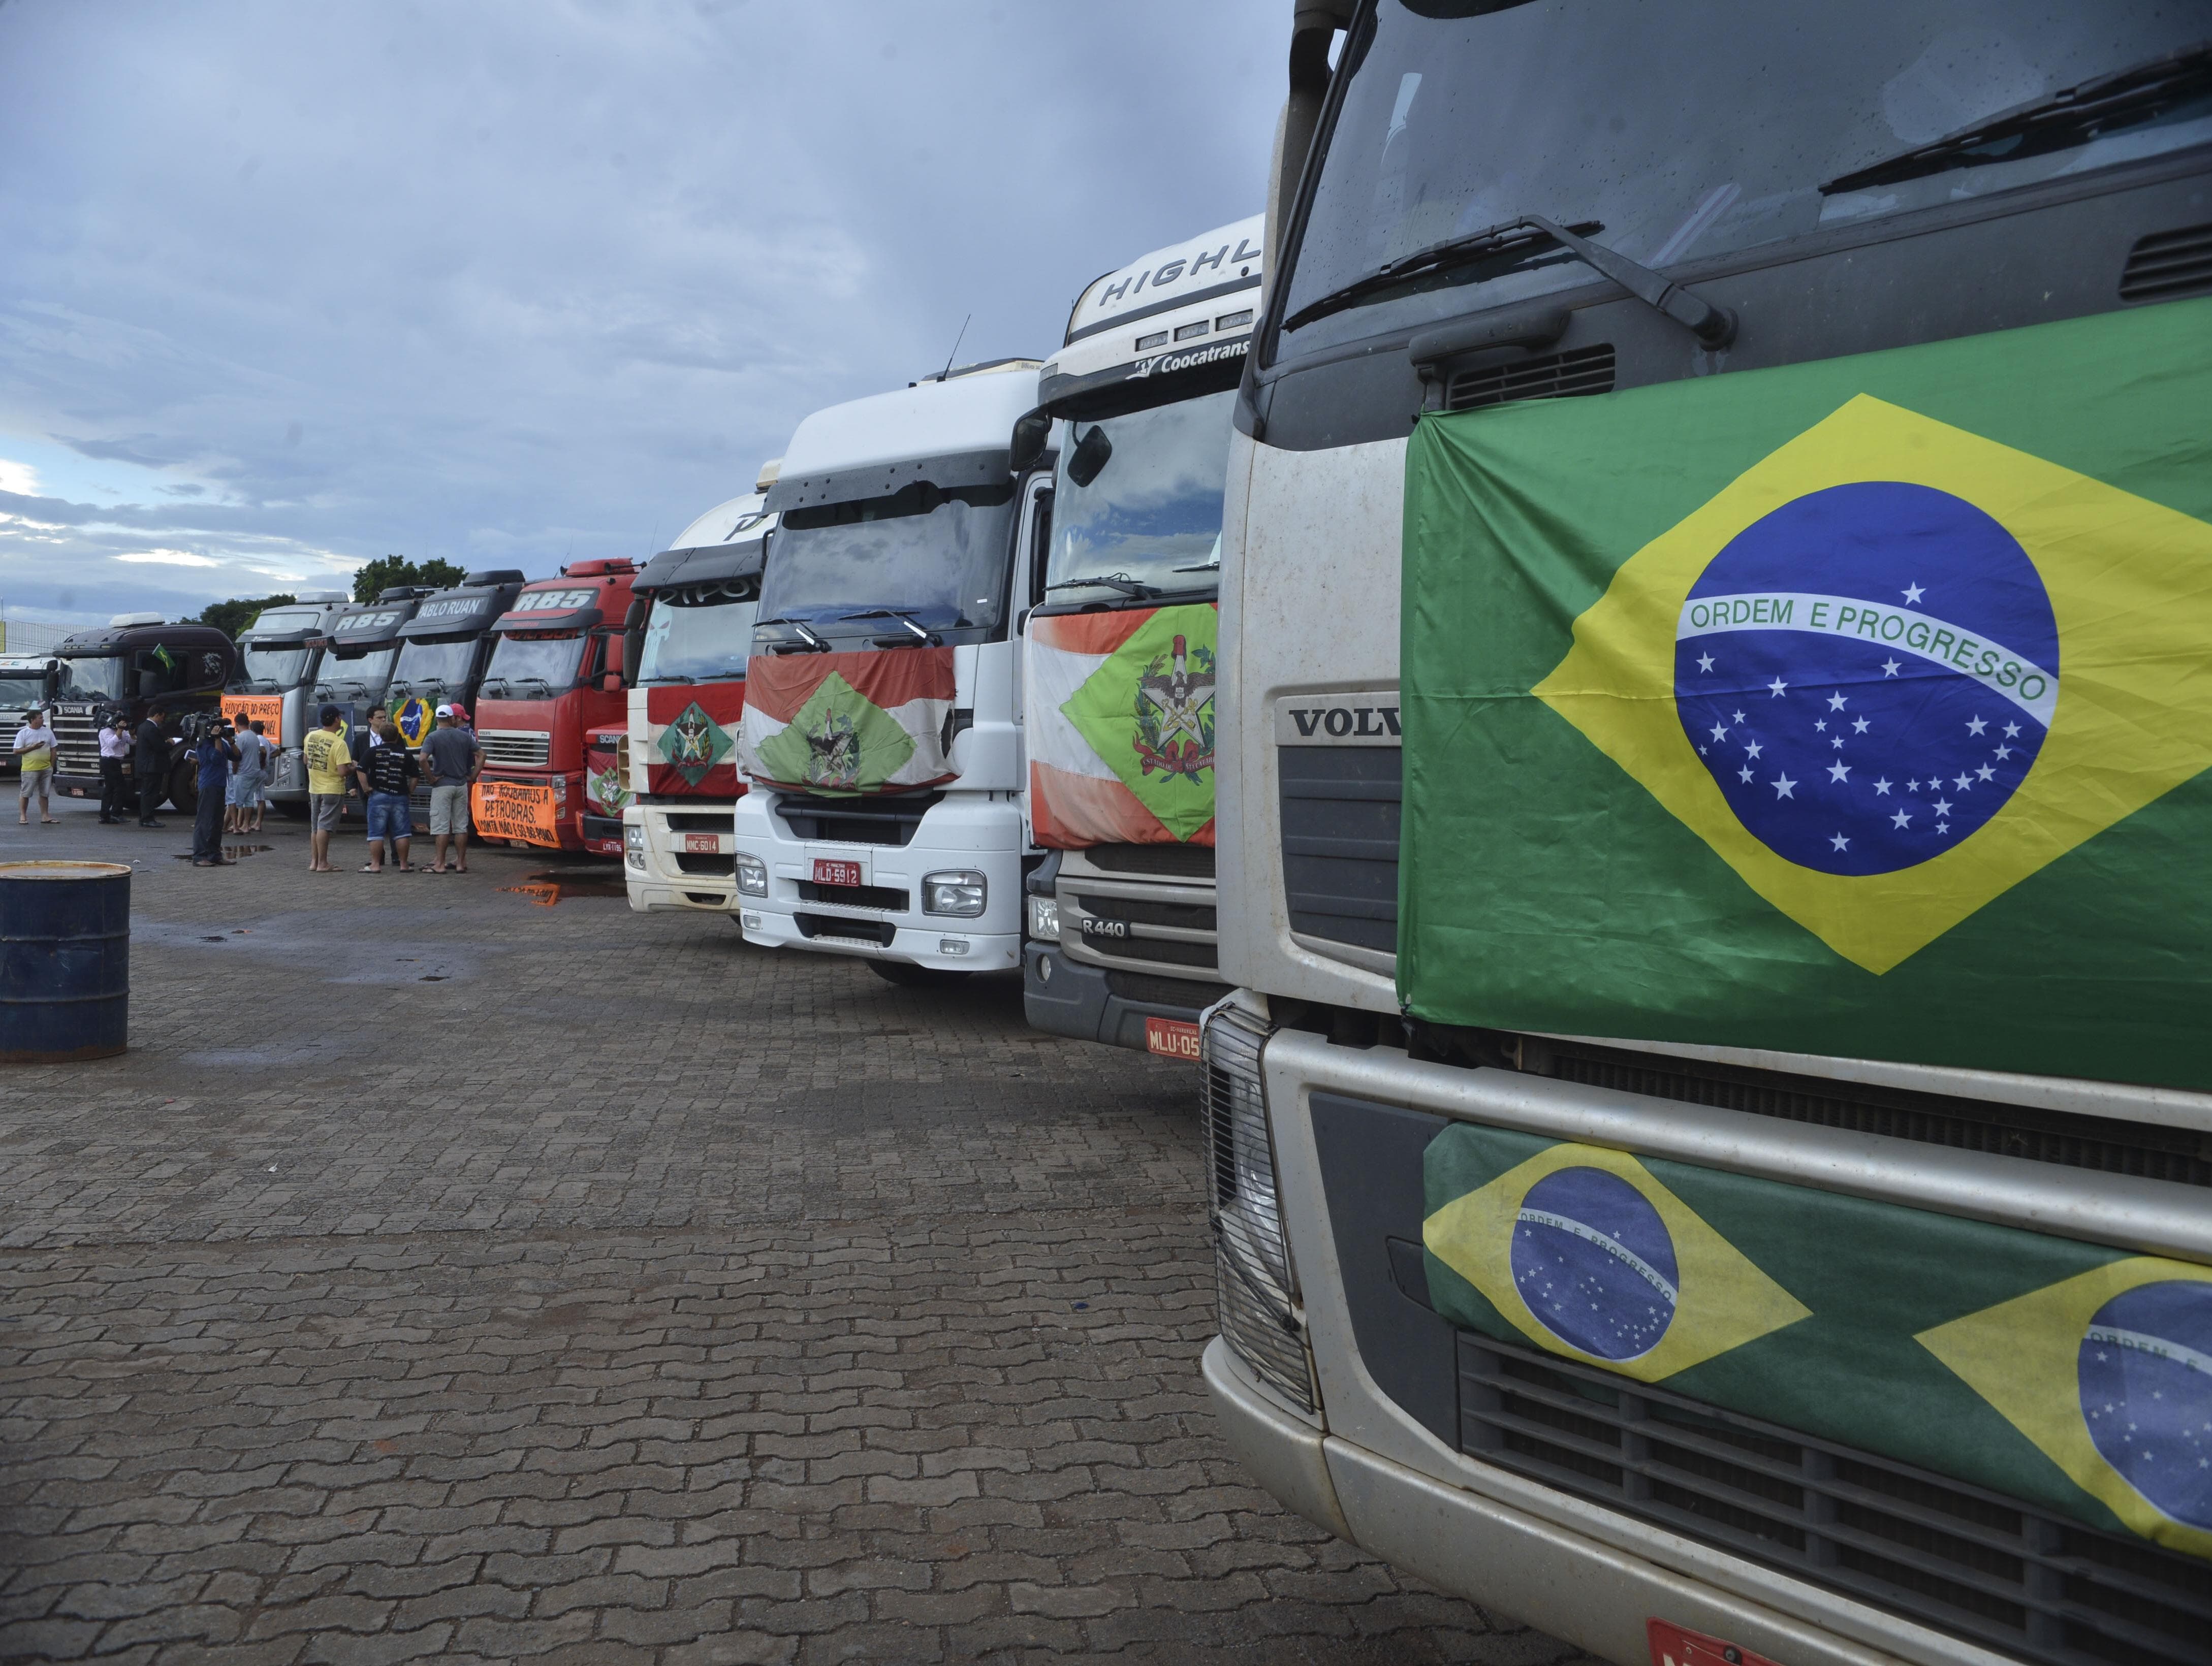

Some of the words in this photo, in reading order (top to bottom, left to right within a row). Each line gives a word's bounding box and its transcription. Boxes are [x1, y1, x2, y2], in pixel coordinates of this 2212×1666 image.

[1099, 238, 1261, 306] HIGHL
[1161, 340, 1250, 373] Coocatrans
[416, 603, 449, 619] PABLO
[449, 600, 481, 616] RUAN
[512, 589, 595, 612] RB5
[334, 611, 400, 631] RB5
[1691, 598, 1793, 628] ORDEM
[1810, 602, 1830, 627] E
[1836, 606, 2046, 701] PROGRESSO
[259, 702, 279, 717] PREÇO
[599, 734, 621, 744] SCAN
[543, 789, 549, 805] A
[485, 799, 536, 823] PETROBRAS.
[814, 866, 857, 884] MLD-5912
[1083, 919, 1125, 937] R440
[1150, 1031, 1200, 1056] MLU-05
[1521, 1212, 1563, 1229] ORDEM
[1574, 1227, 1581, 1235] E
[1591, 1235, 1672, 1301] PROGRESSO
[2090, 1332, 2168, 1360] ORDEM
